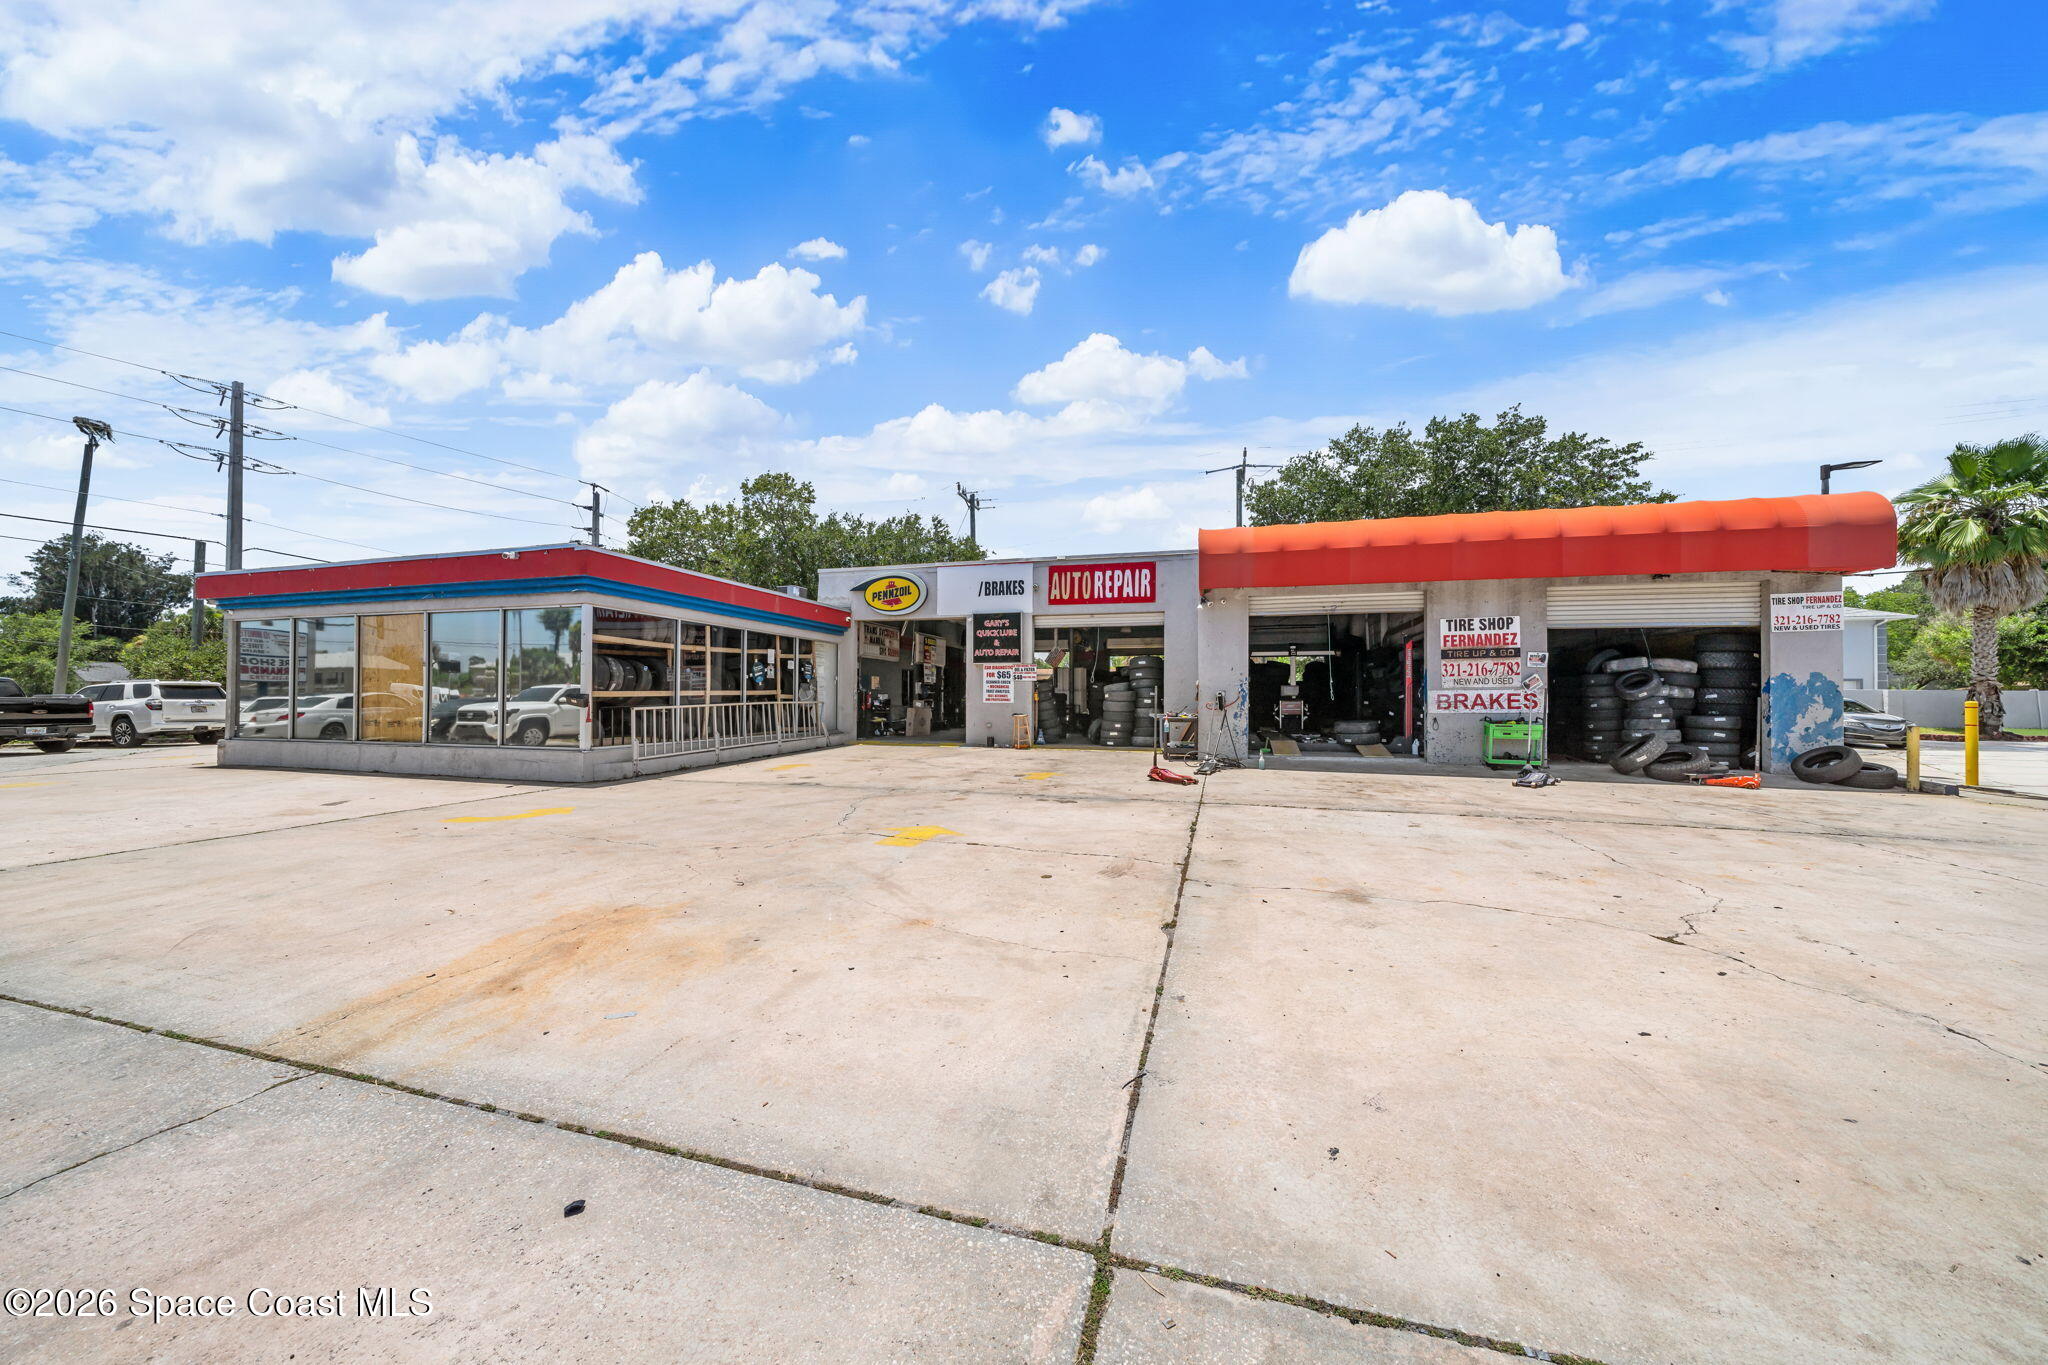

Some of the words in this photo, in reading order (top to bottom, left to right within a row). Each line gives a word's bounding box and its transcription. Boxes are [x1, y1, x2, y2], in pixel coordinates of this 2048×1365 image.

[1050, 571, 1091, 600] AUTO
[1094, 569, 1151, 598] REPAIR
[872, 585, 912, 602] PENNZOIL
[1787, 596, 1804, 605] SHOP
[1805, 595, 1842, 604] FERNANDEZ
[984, 619, 1010, 627] GARY'S
[1446, 618, 1475, 632] TIRE
[1479, 617, 1514, 631] SHOP
[1773, 614, 1841, 625] 321-216-7782
[976, 629, 999, 637] QUICK
[1443, 633, 1518, 648] FERNANDEZ
[1447, 650, 1470, 658] TIRE
[996, 670, 1011, 679] $65
[1442, 662, 1521, 678] 321-216-7782
[1453, 678, 1472, 686] NEW
[1473, 677, 1490, 685] AND
[1492, 677, 1514, 685] USED
[1436, 692, 1539, 710] BRAKES
